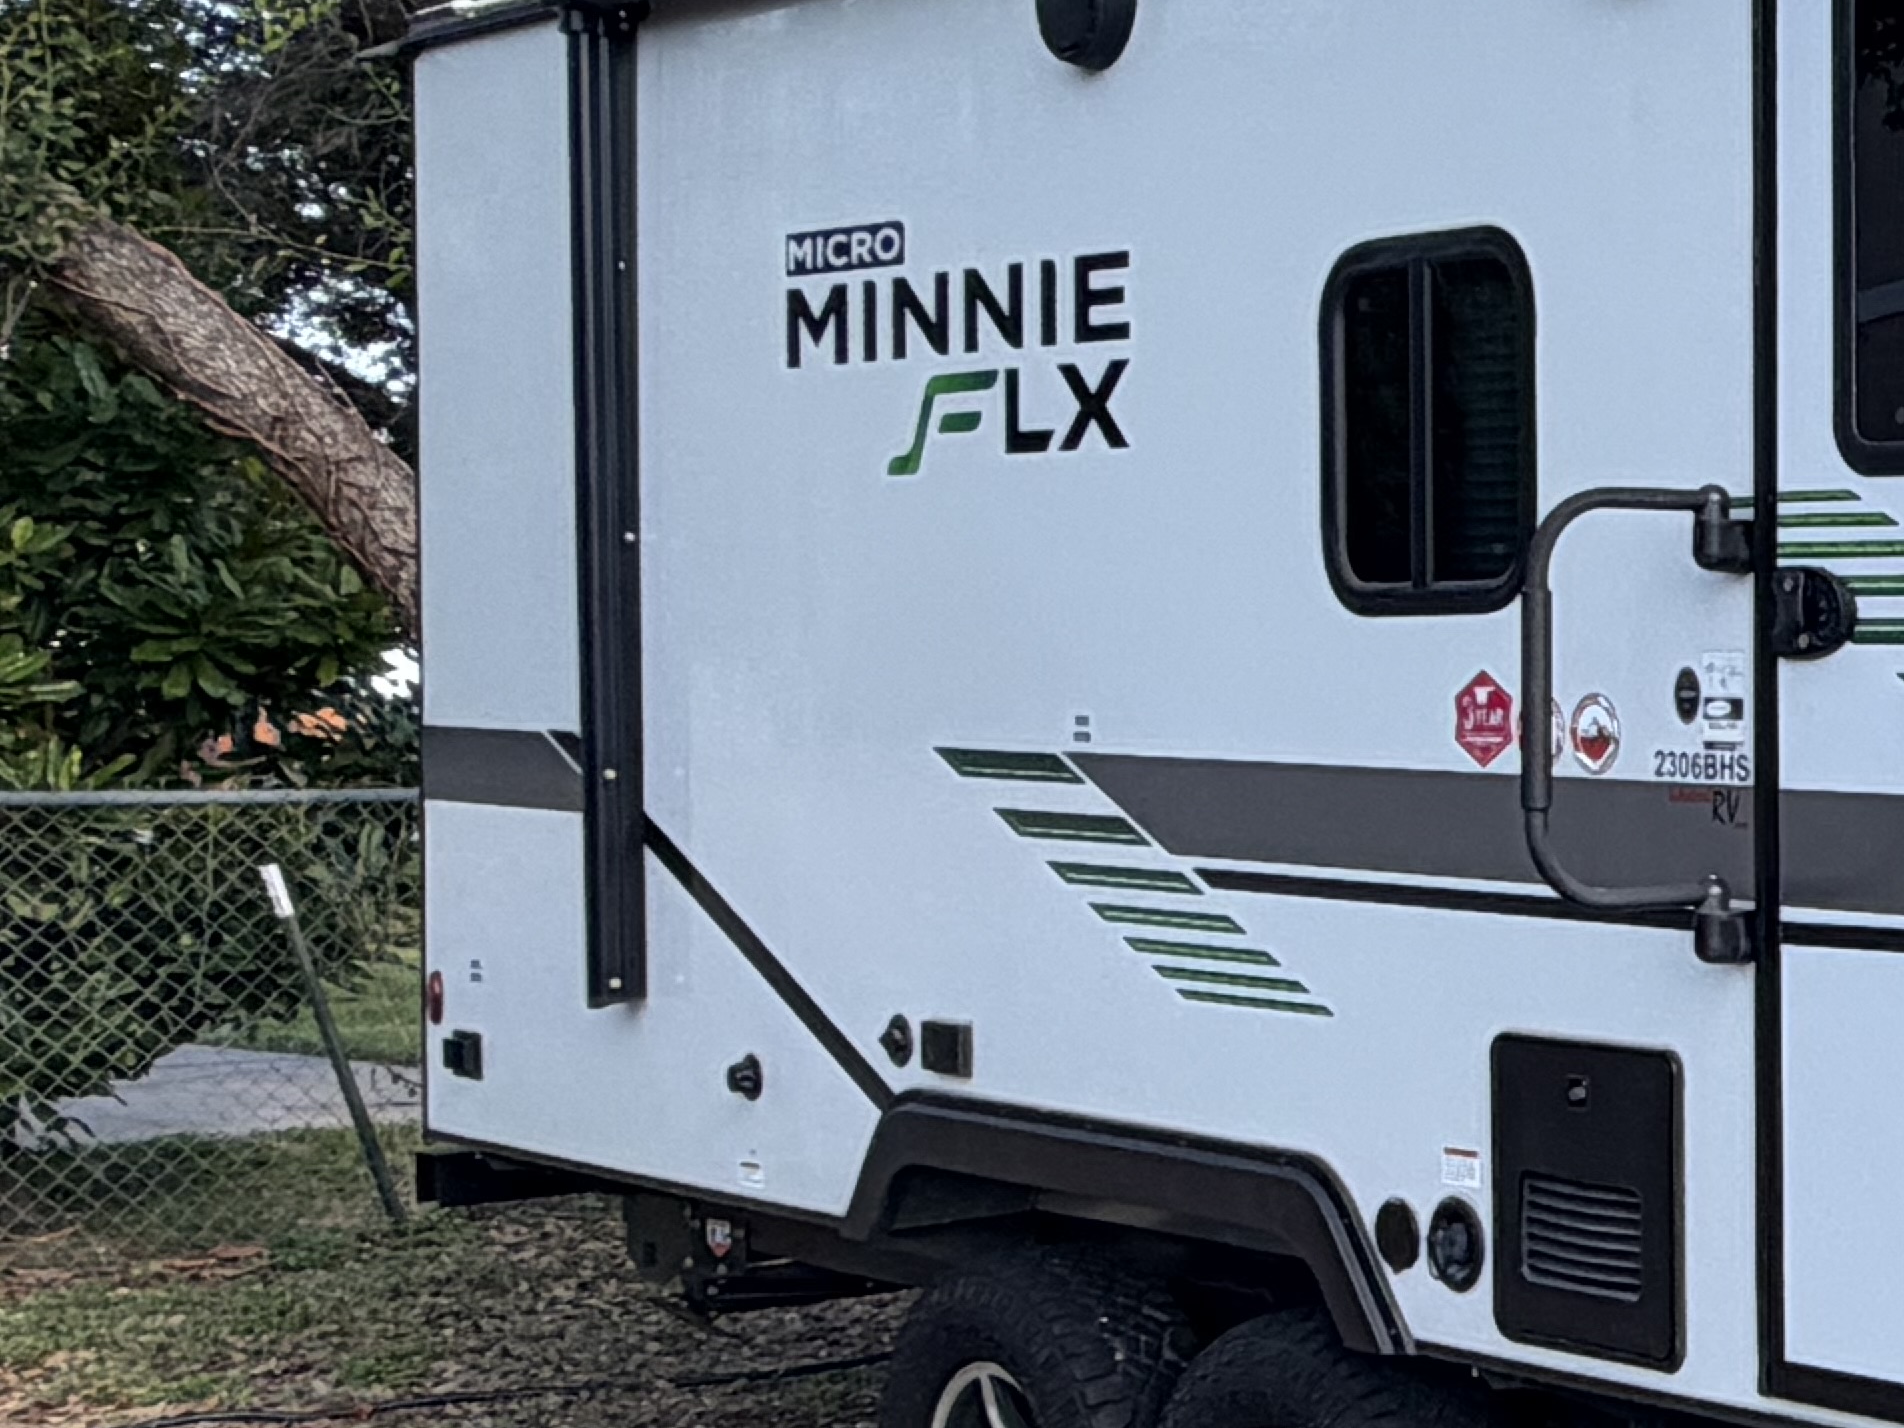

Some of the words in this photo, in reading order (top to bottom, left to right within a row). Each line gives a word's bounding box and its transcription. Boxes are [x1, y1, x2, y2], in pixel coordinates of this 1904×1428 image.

[788, 226, 901, 271] MICRO
[786, 250, 1131, 369] MINNIE
[886, 358, 1131, 476] FLX
[1653, 749, 1751, 781] 2306BHS
